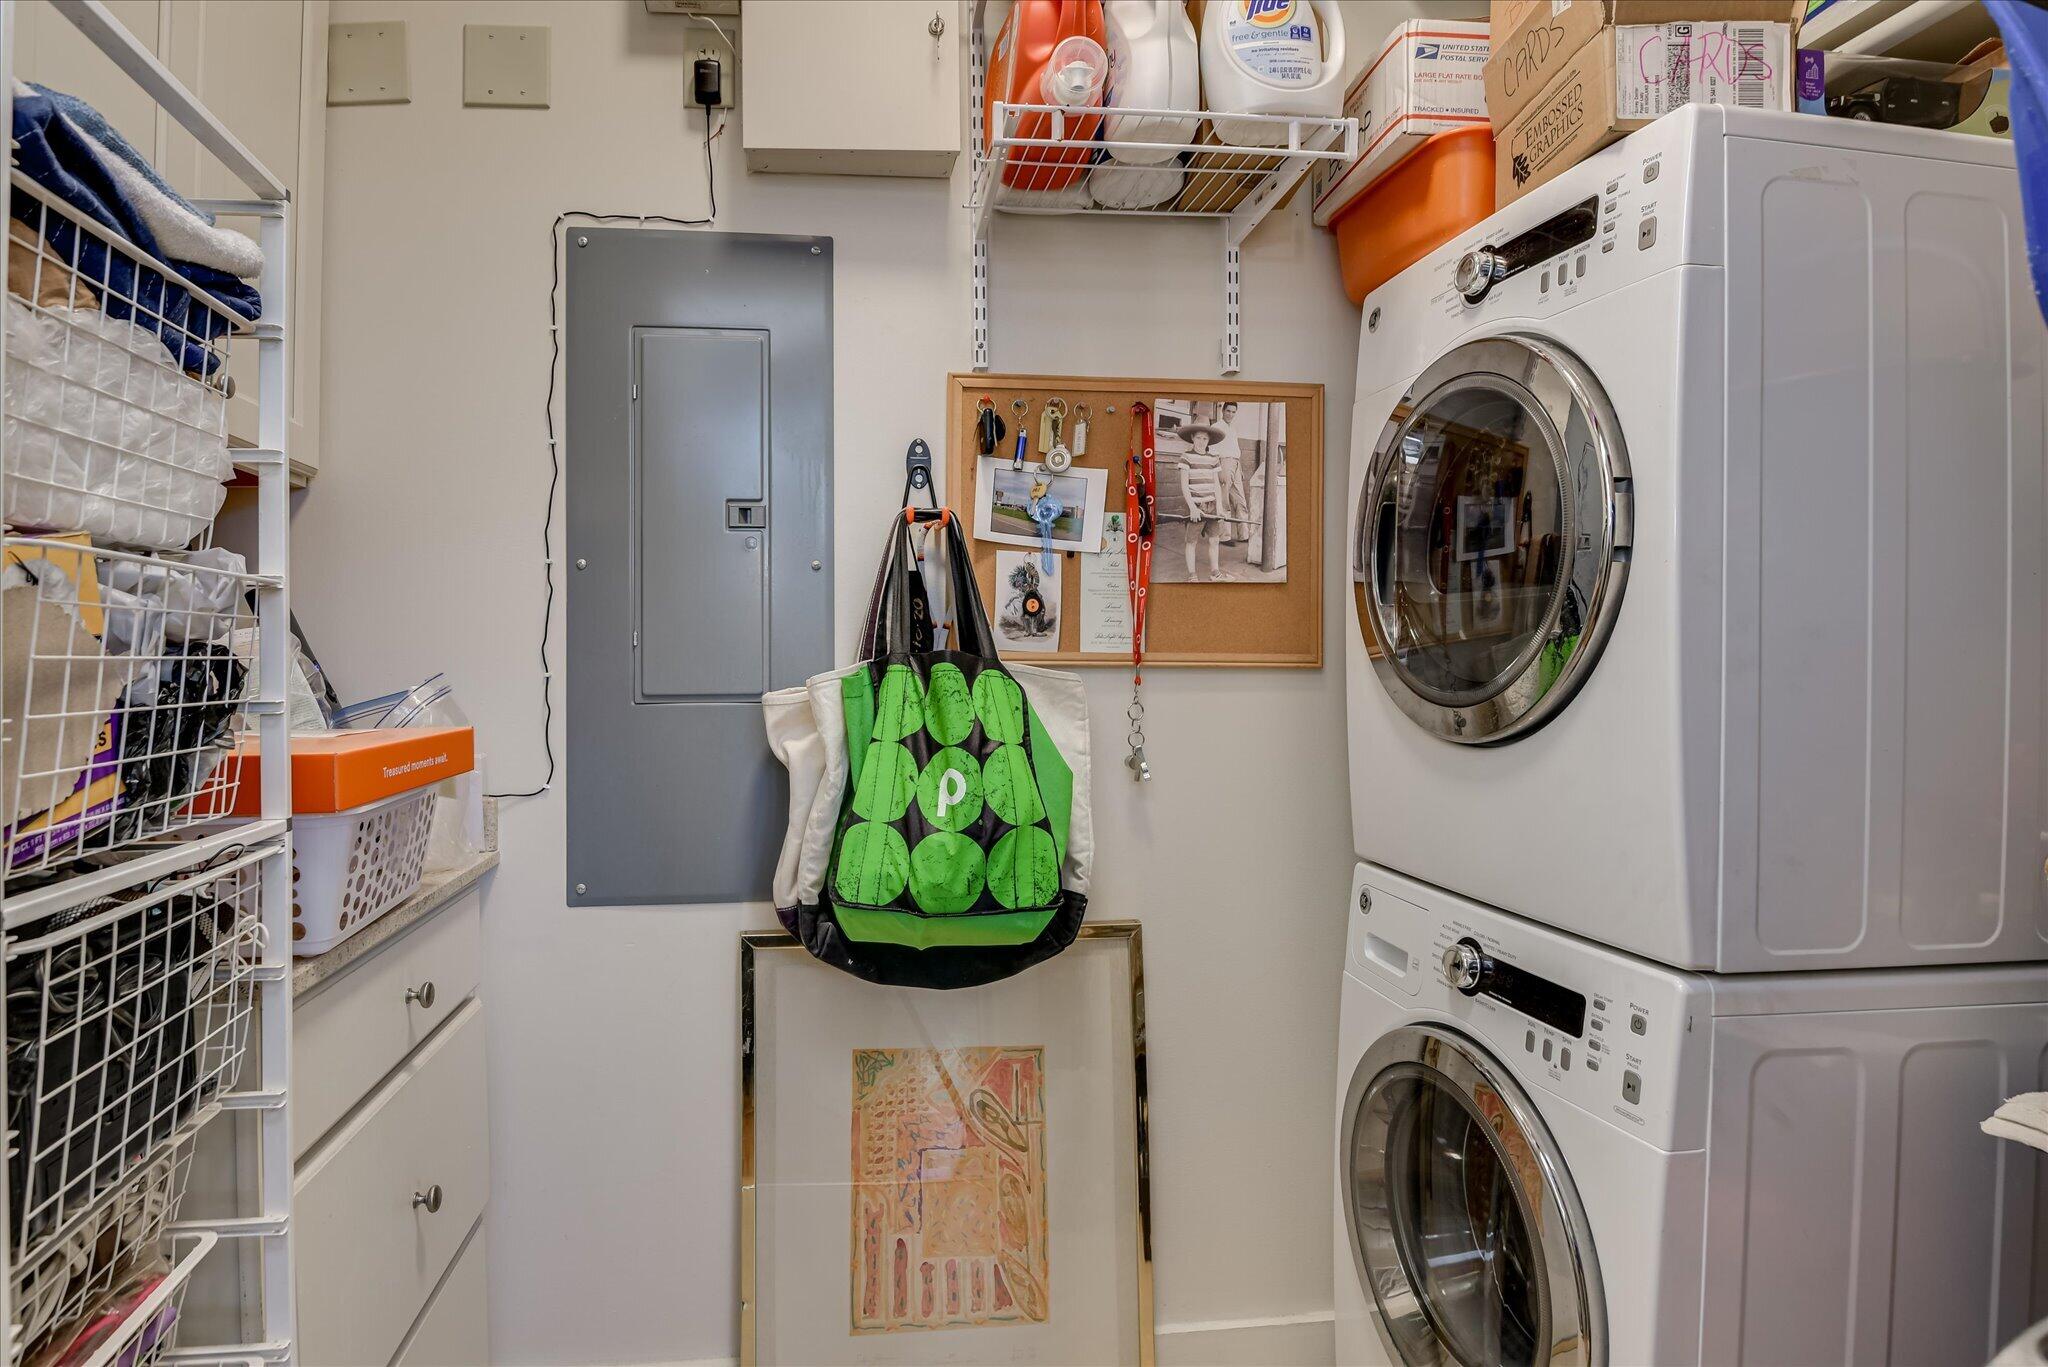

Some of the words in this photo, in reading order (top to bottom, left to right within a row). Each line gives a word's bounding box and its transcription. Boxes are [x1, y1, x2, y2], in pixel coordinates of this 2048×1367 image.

[1232, 34, 1249, 42] free
[1250, 31, 1260, 40] &
[1260, 29, 1288, 39] gentle
[1677, 26, 1690, 35] G
[1442, 44, 1469, 52] UNITED
[1504, 17, 1565, 98] CARDS
[1639, 31, 1773, 86] CARDS
[1525, 84, 1582, 149] EMBOSSED
[1529, 101, 1584, 163] GRAPHICS
[1642, 152, 1662, 166] POWER
[1641, 201, 1657, 213] START
[1574, 244, 1591, 255] SENSOR
[1558, 253, 1570, 261] TEMP
[382, 762, 411, 778] Treasured
[411, 758, 434, 771] moments
[434, 752, 448, 764] await.
[1629, 1002, 1649, 1015] POWER
[1527, 1020, 1536, 1028] SOIL
[1544, 1027, 1555, 1036] TEMP
[1562, 1036, 1572, 1045] SPIN
[1626, 1053, 1642, 1064] START
[1627, 1062, 1639, 1070] PAUSE
